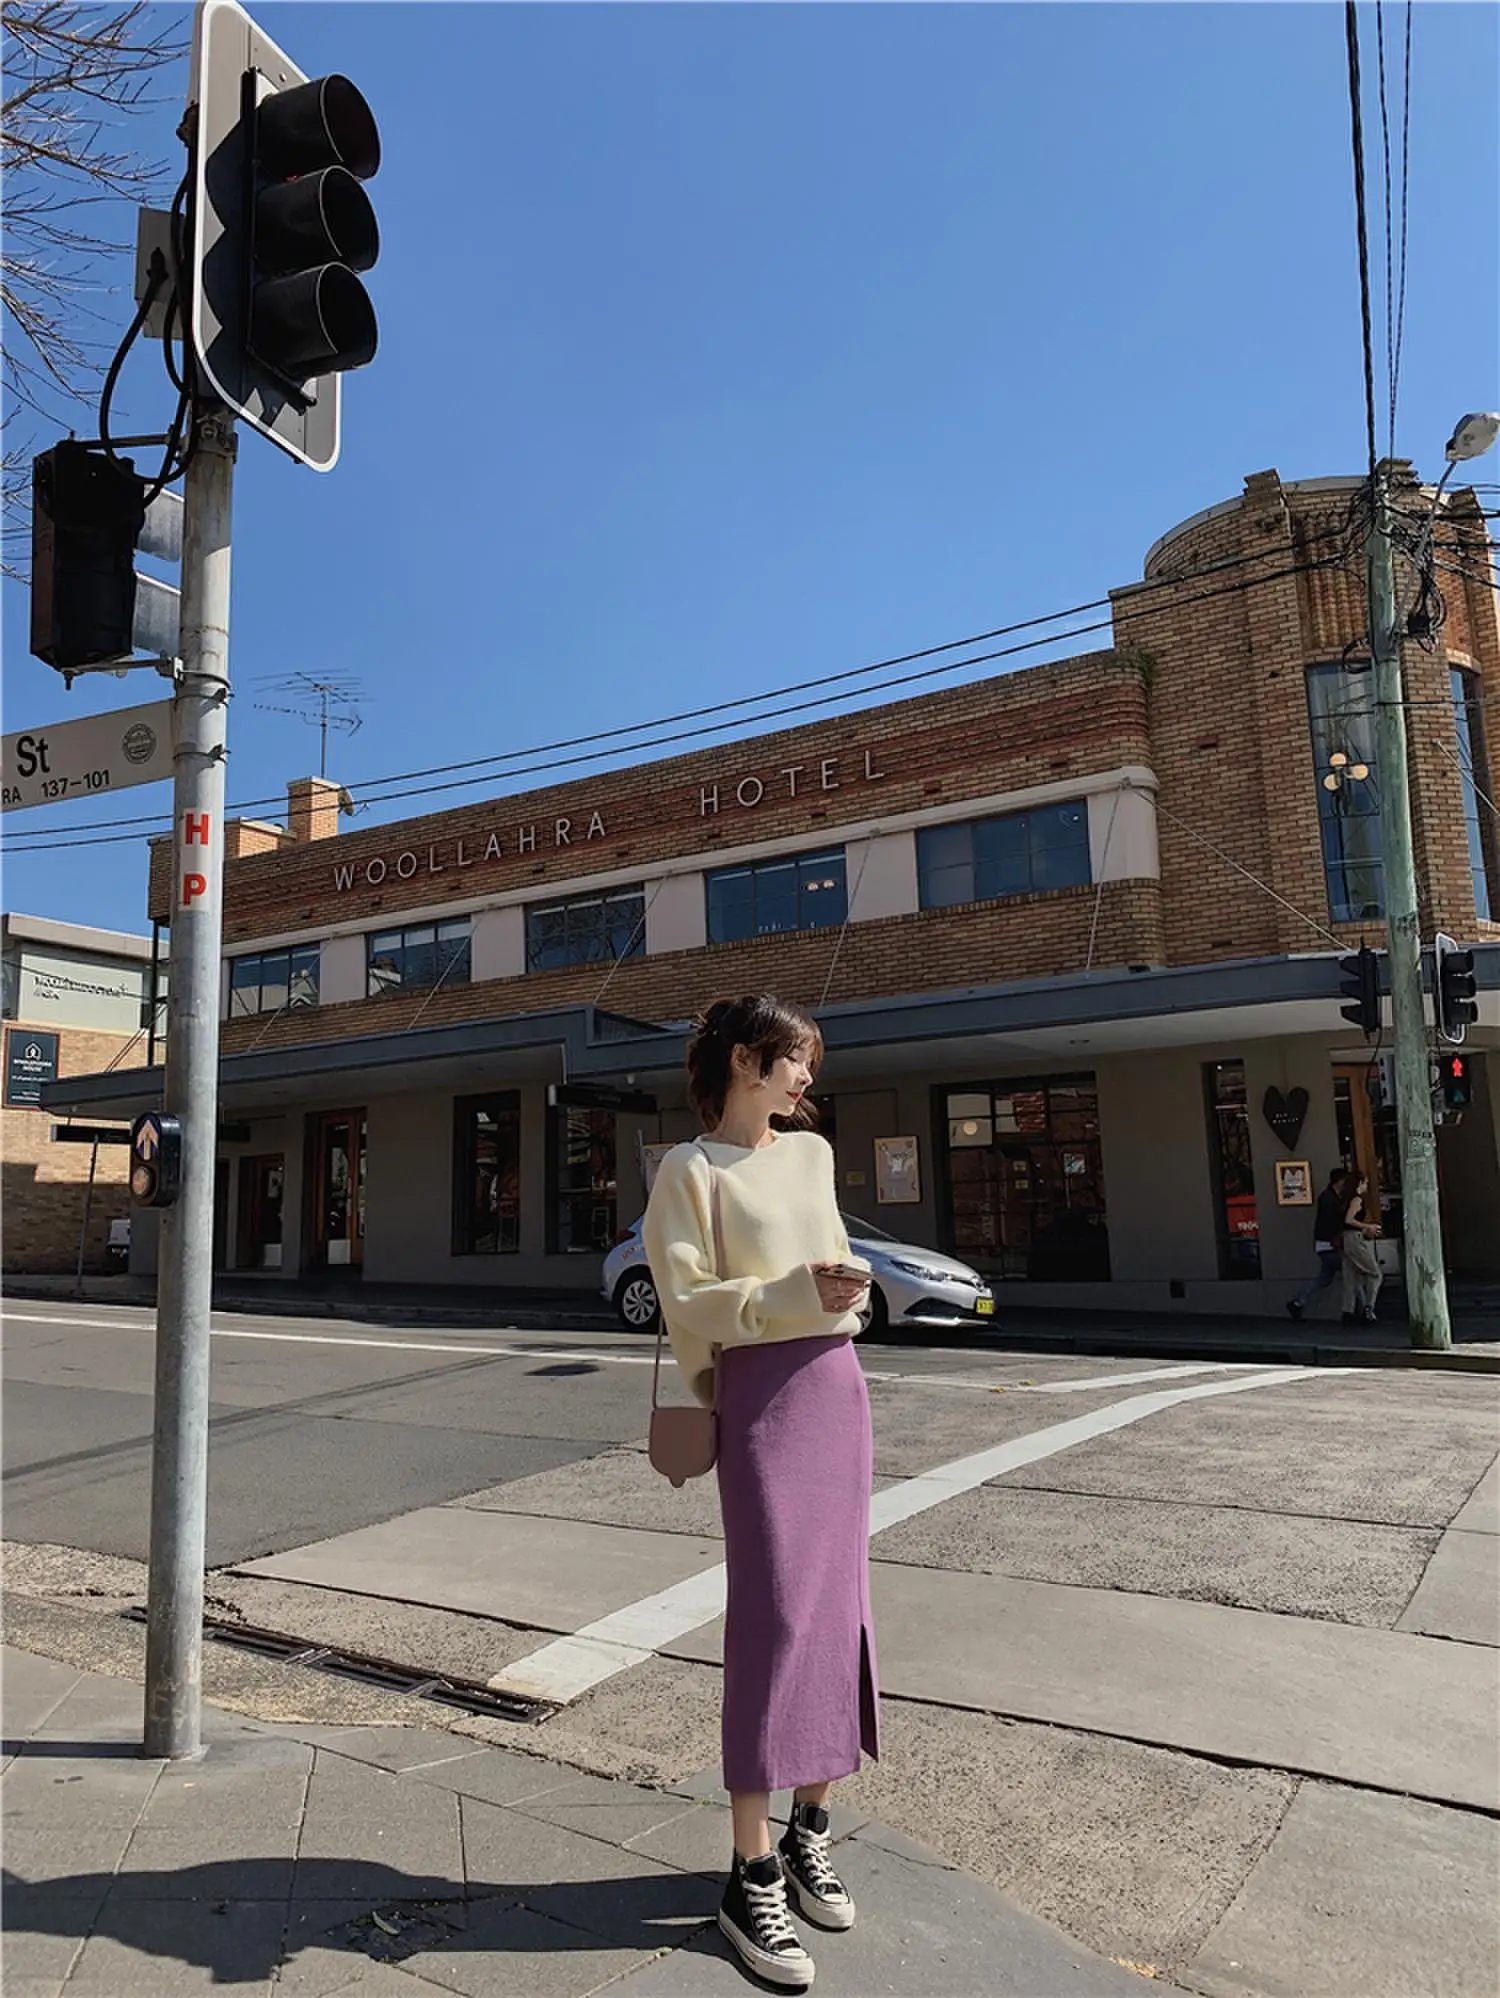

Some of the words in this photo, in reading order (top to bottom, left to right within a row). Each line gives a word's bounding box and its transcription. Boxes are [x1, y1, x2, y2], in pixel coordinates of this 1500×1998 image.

[16, 735, 50, 777] St
[41, 769, 110, 798] 137-101
[334, 811, 606, 891] WOOLLAHRA
[700, 750, 885, 817] HOTEL
